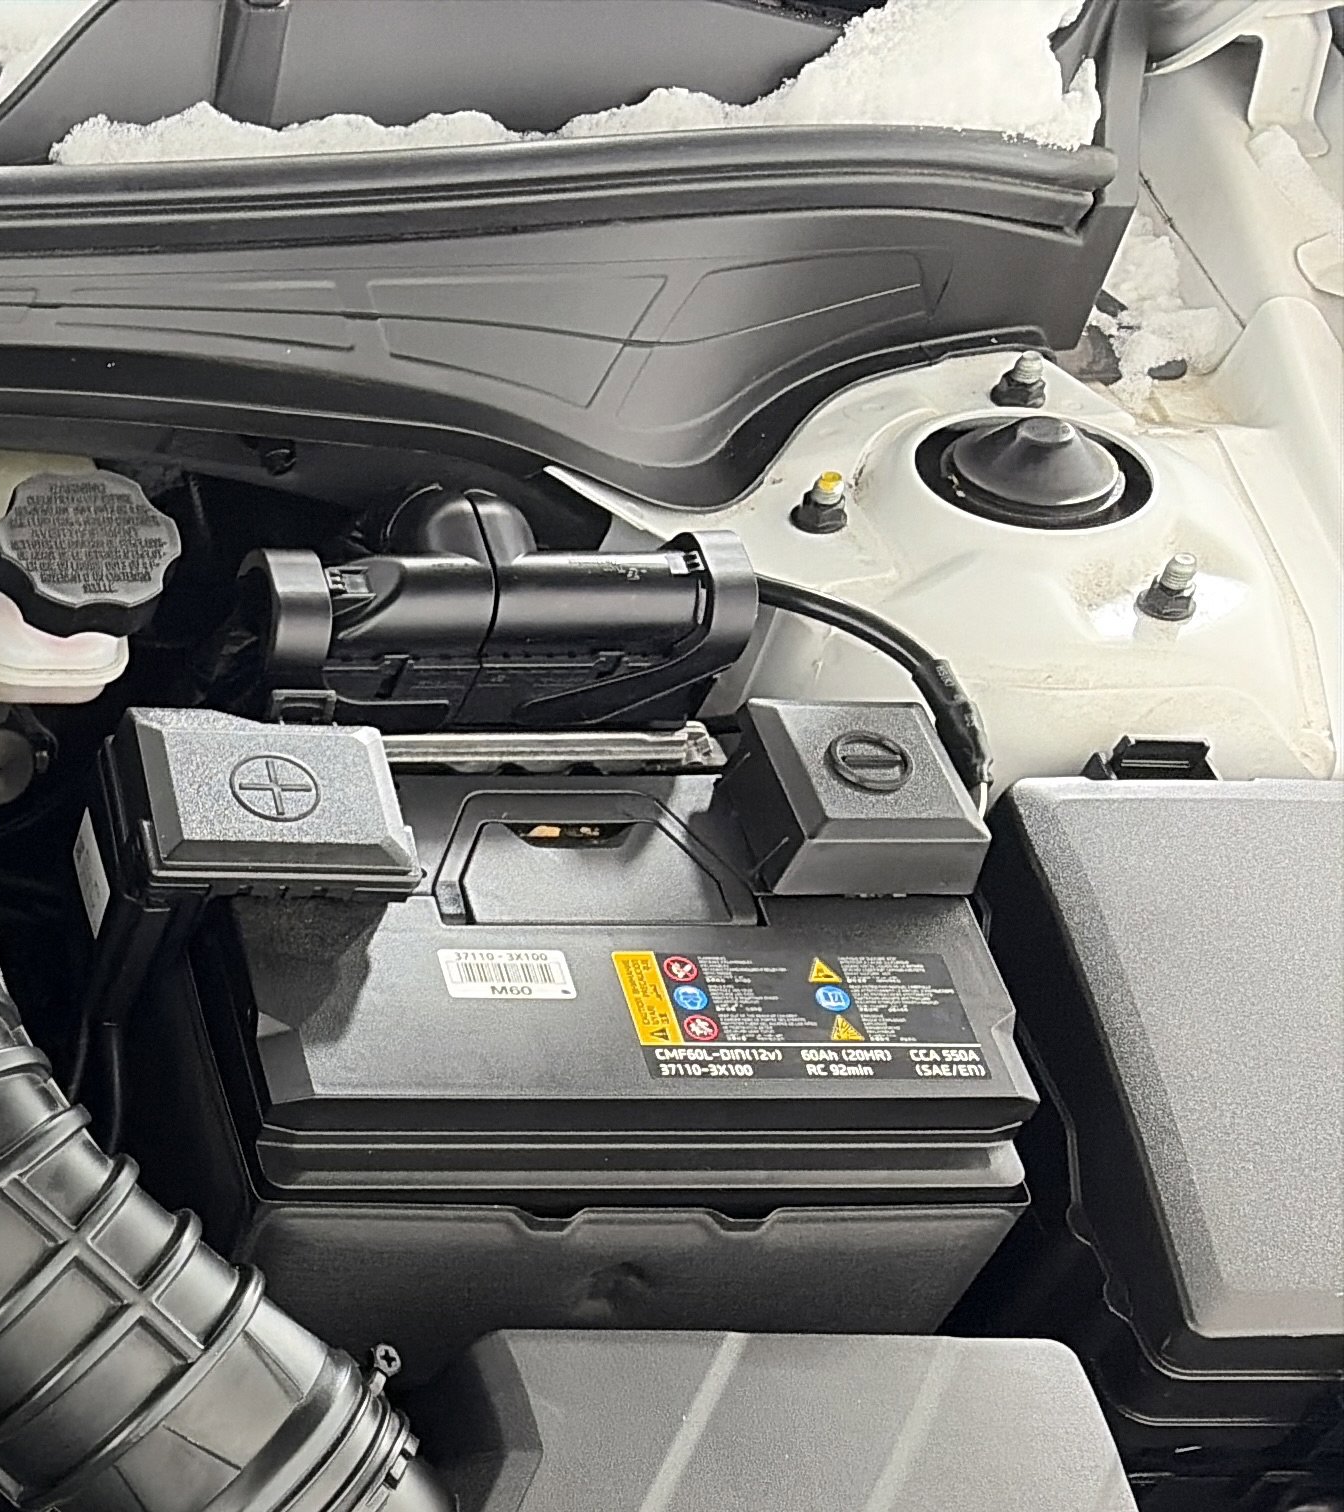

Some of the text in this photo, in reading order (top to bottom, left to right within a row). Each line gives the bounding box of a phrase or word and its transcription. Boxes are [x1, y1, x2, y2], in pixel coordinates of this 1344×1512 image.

[490, 985, 533, 997] M60
[800, 1049, 839, 1062] 60Ah
[841, 1048, 892, 1062] (20HR)
[909, 1049, 940, 1062] CCA
[941, 1049, 980, 1062] 550A
[659, 1063, 754, 1077] 37110-3X100
[805, 1063, 828, 1076] RC
